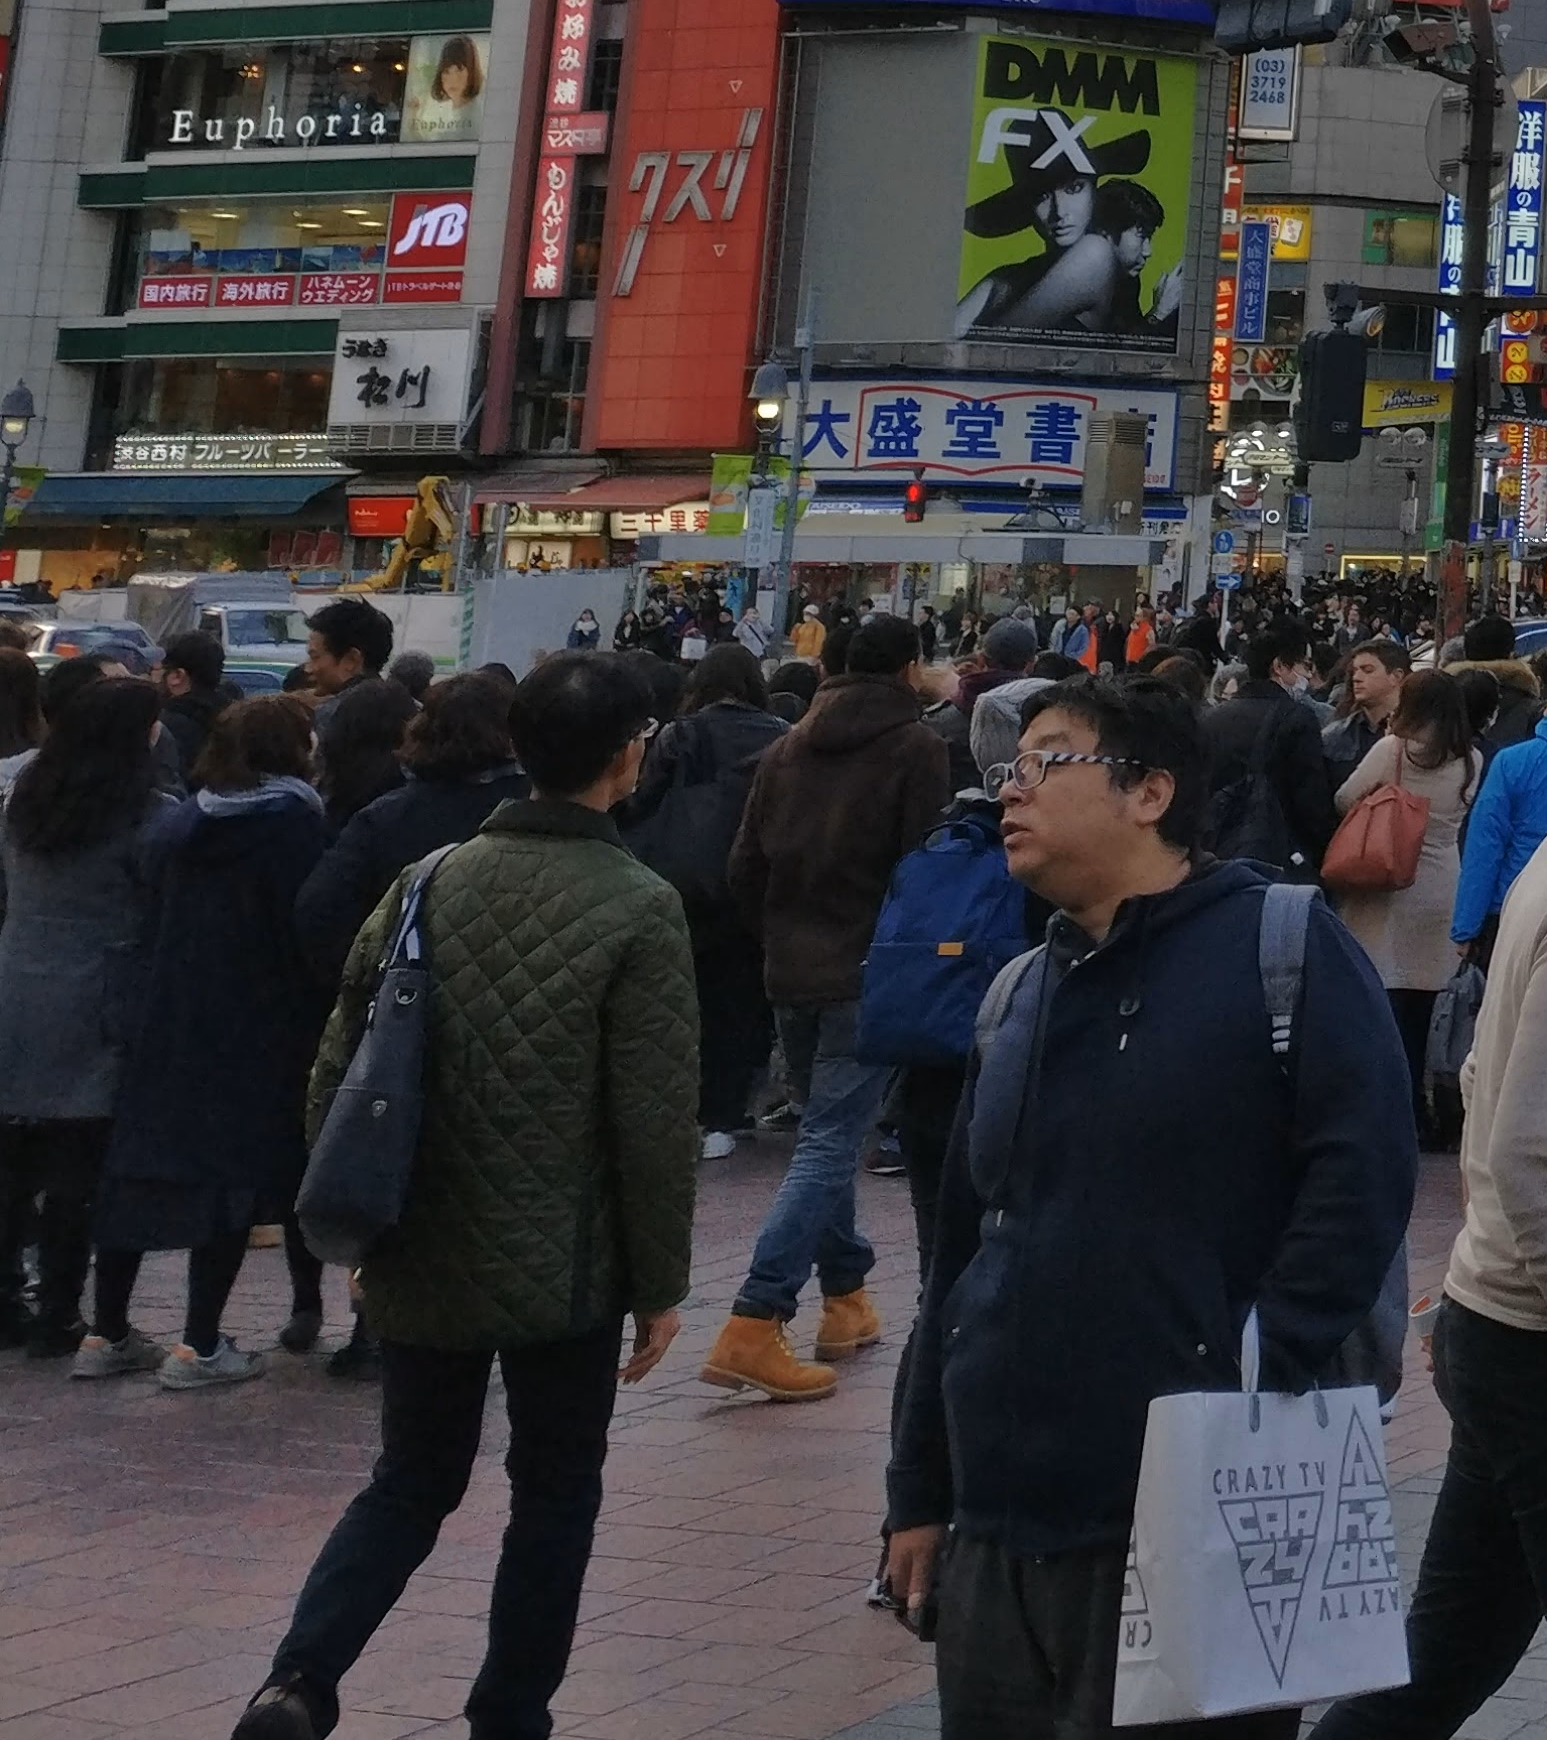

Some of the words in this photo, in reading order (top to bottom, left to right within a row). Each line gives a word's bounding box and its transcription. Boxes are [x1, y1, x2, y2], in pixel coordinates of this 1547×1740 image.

[983, 41, 1160, 116] DMM
[1250, 75, 1287, 89] 3719
[1255, 58, 1285, 73] (03)
[1250, 89, 1285, 104] 2468
[168, 103, 387, 151] Euphoria
[411, 116, 473, 133] Euphoria
[977, 106, 1098, 174] FX
[612, 108, 763, 297] クスリ
[1505, 110, 1542, 287] 洋服の青山
[394, 203, 468, 255] JTB
[533, 162, 567, 290] もんじゃ焼
[143, 283, 209, 303] 国内旅行
[222, 280, 290, 302] 海外旅行
[301, 287, 375, 305] ウエディング
[307, 274, 372, 289] ハネムーン
[802, 396, 1158, 466] 大盛堂書
[119, 444, 187, 462] 渋谷西村
[194, 444, 326, 461] フルーツパーラー
[1526, 466, 1541, 531] ラーメン
[1213, 1464, 1287, 1495] CRAZY
[1301, 1460, 1326, 1487] TV
